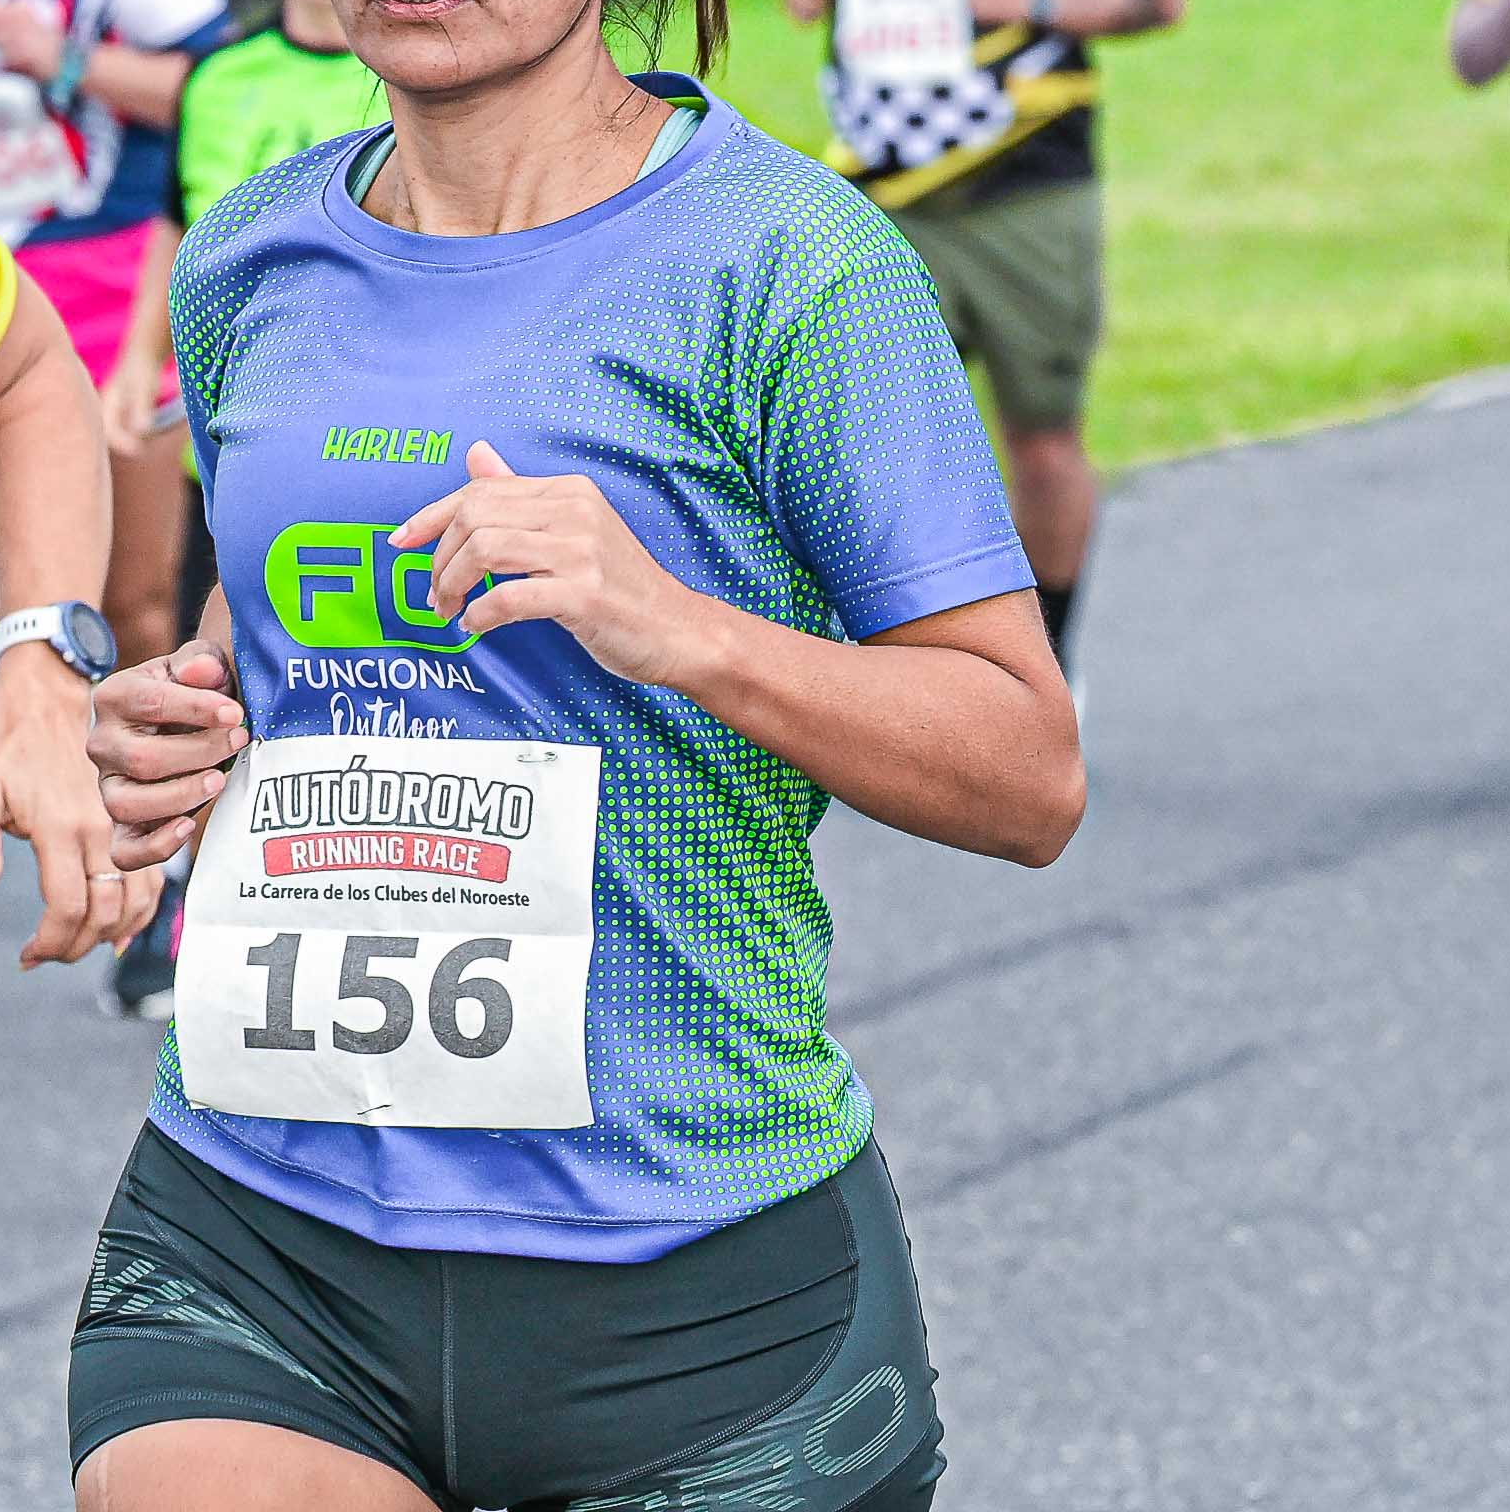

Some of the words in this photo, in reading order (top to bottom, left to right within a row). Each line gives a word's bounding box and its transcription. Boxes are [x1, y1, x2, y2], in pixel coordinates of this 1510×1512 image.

[321, 425, 453, 466] HARLEM
[286, 656, 487, 695] FUNCIONAL
[329, 691, 459, 738] Outdoor
[251, 754, 534, 840] AUTÓDROMO
[290, 835, 405, 871] RUNNING
[412, 839, 483, 876] RACE
[239, 882, 257, 899] La
[260, 883, 319, 900] Carrera
[323, 883, 344, 900] de
[348, 884, 371, 901] los
[374, 885, 428, 903] Clubes
[431, 885, 456, 904] del
[460, 887, 531, 907] Noroeste
[242, 931, 515, 1060] 156
